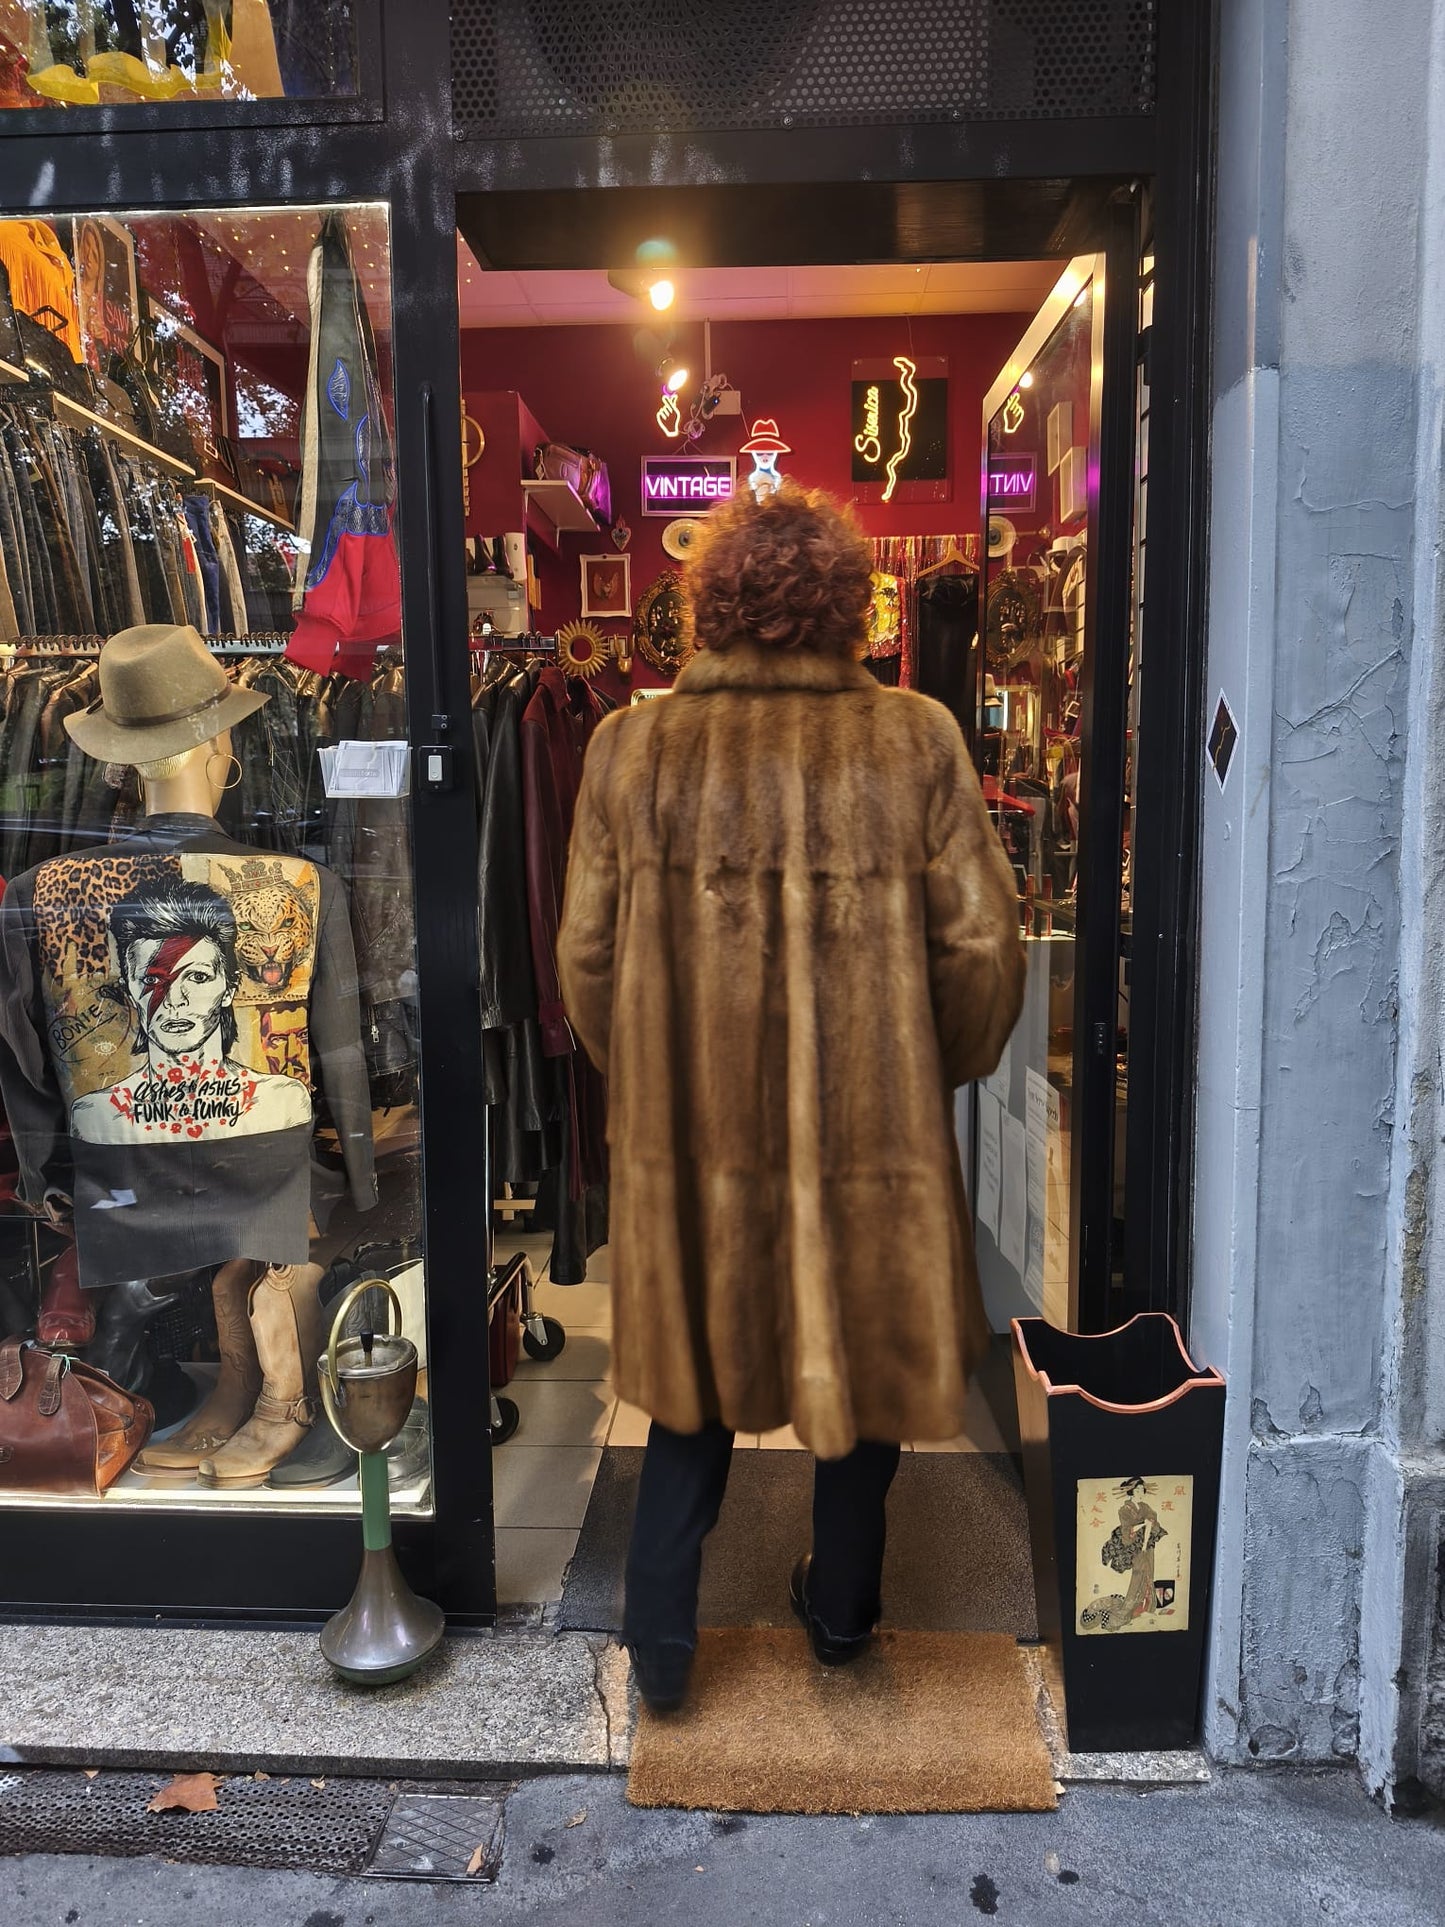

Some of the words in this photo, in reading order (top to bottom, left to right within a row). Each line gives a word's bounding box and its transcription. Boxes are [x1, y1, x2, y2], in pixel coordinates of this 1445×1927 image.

[645, 476, 732, 497] VINTAGE
[53, 1003, 103, 1050] BOWIE
[198, 1078, 241, 1096] ASHES
[134, 1103, 176, 1123] FUNK
